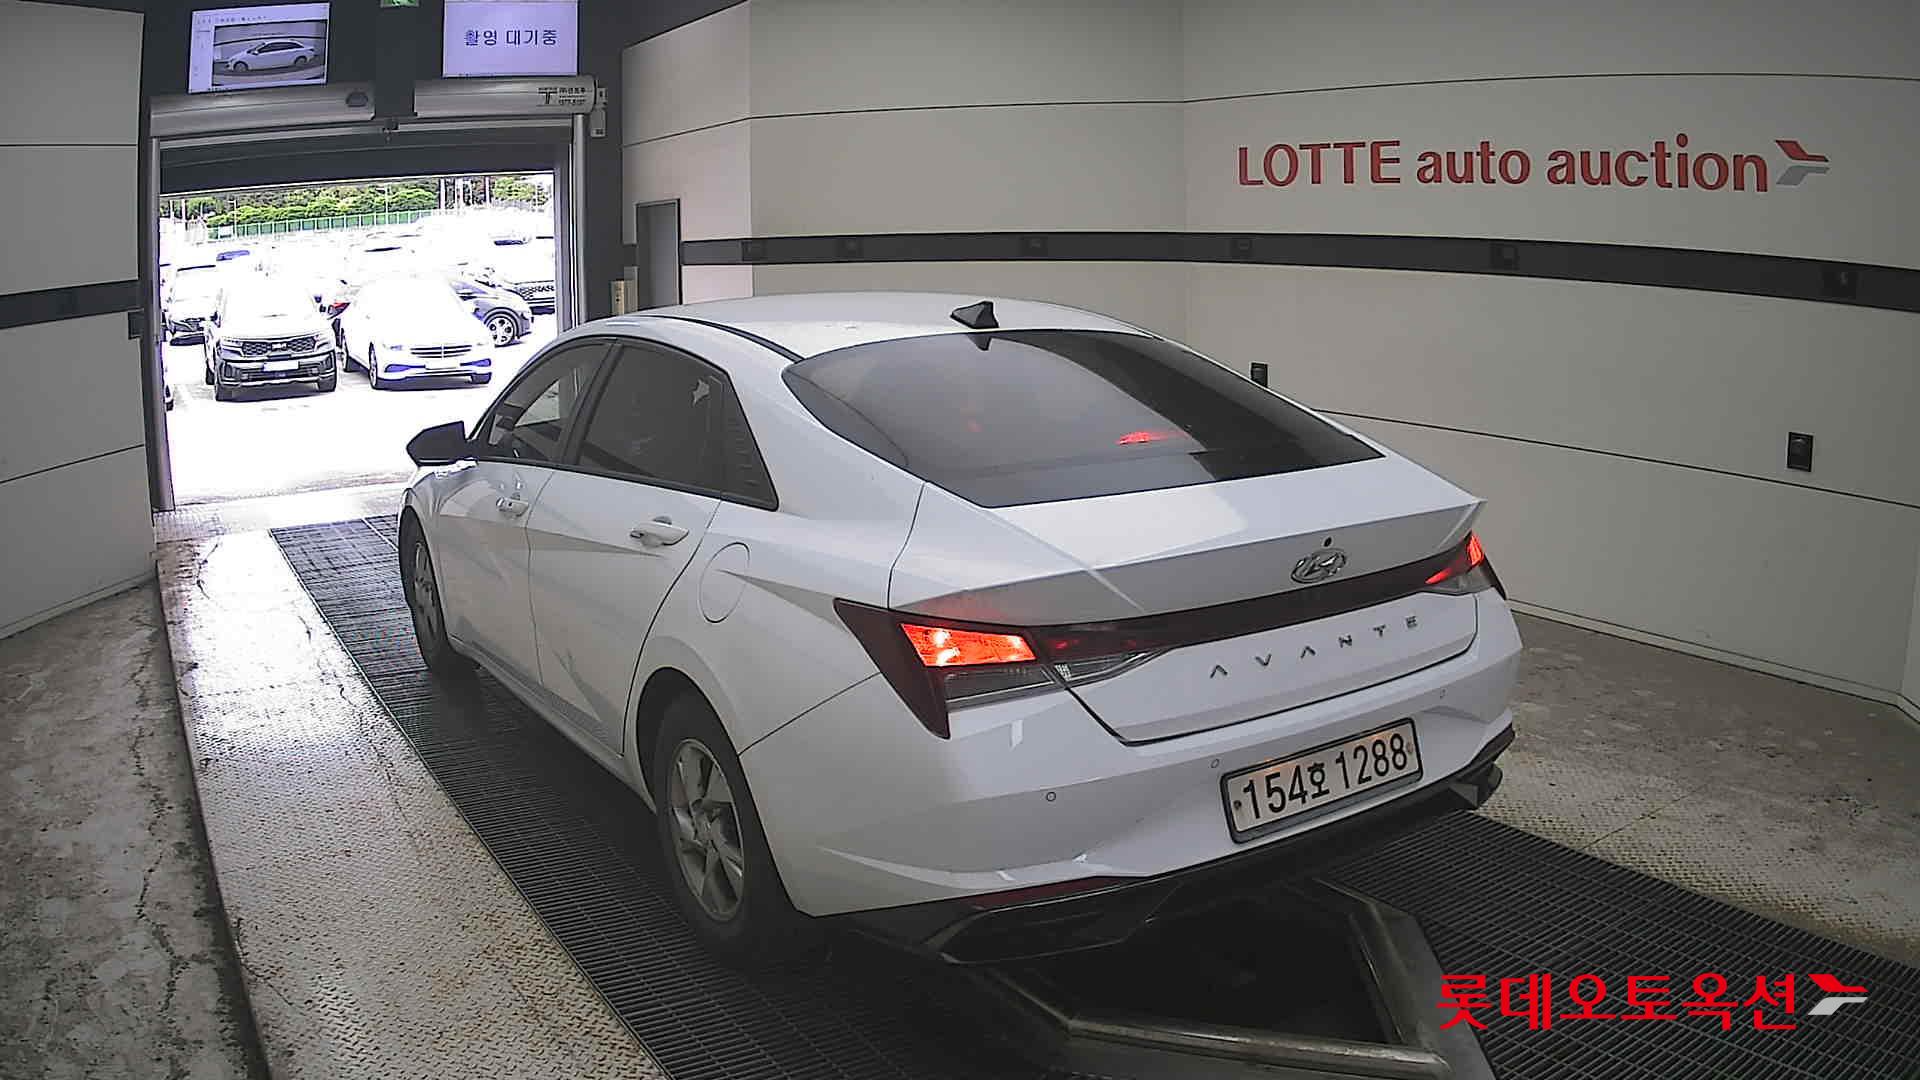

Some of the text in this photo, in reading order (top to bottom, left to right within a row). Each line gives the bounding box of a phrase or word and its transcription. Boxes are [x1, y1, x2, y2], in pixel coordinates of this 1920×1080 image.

[506, 29, 558, 46] 대기중
[1238, 133, 1768, 192] LOTTE auto auction
[1209, 615, 1418, 679] AVANTE
[1335, 733, 1408, 789] 1288
